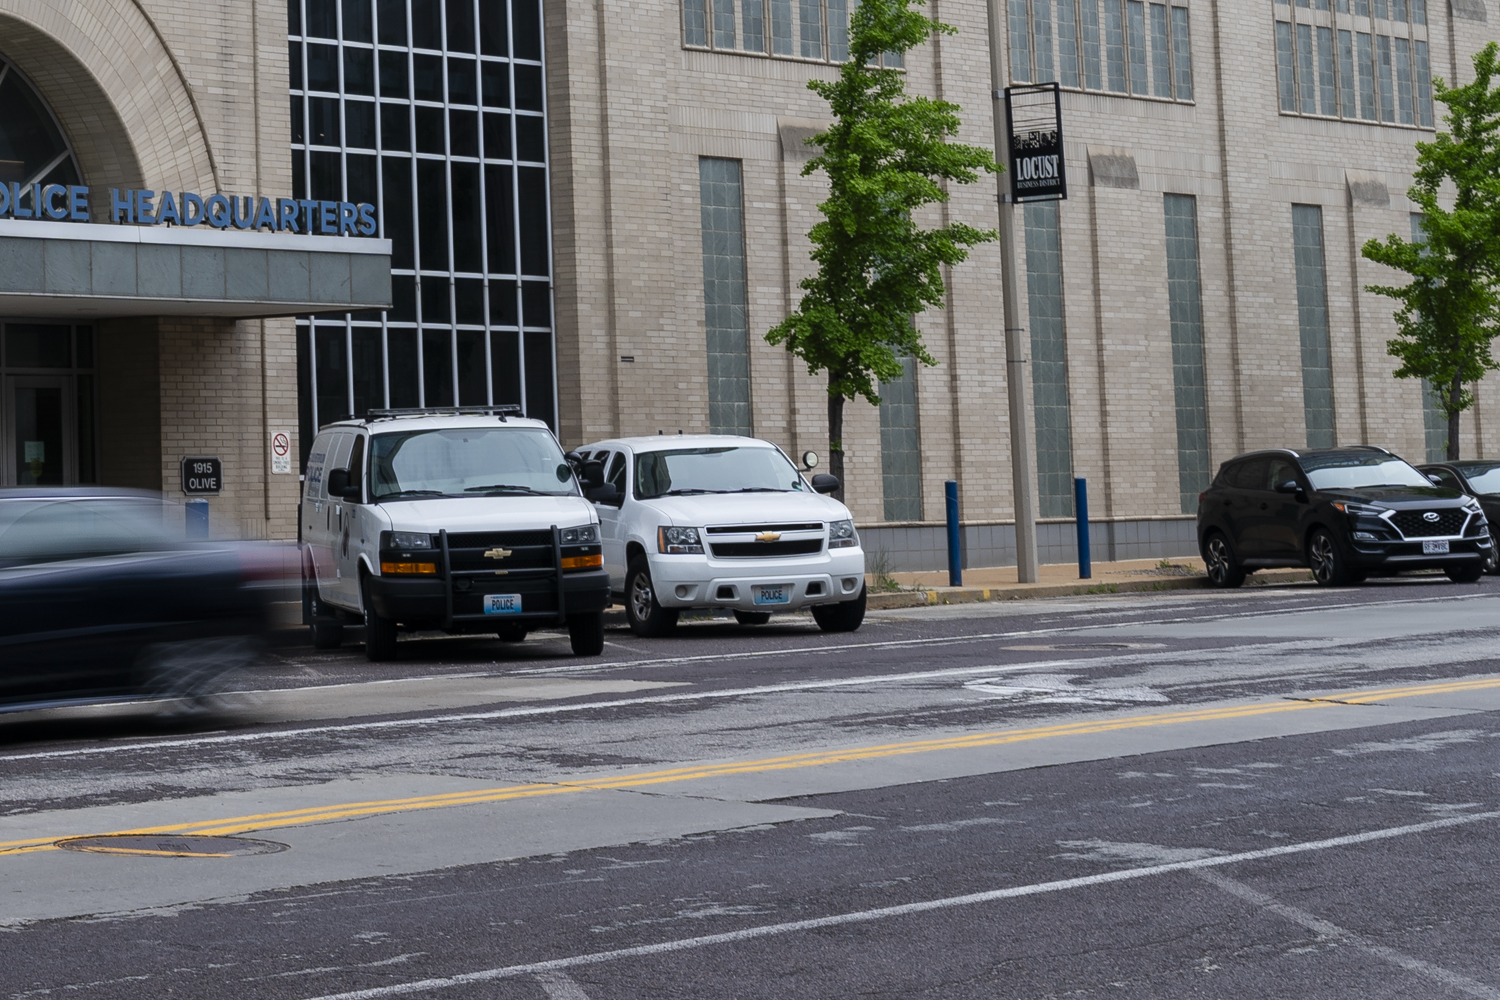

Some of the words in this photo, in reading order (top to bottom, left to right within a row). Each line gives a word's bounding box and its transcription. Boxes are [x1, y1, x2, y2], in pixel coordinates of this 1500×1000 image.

[1015, 154, 1060, 181] LOCUST
[1017, 180, 1040, 189] BUSINESS
[1039, 178, 1060, 187] DISTRICT
[109, 188, 377, 236] HEADQUARTERS
[193, 462, 213, 474] 1915
[189, 477, 217, 489] OLIVE
[761, 589, 783, 601] POLICE
[491, 599, 514, 610] POLICE
